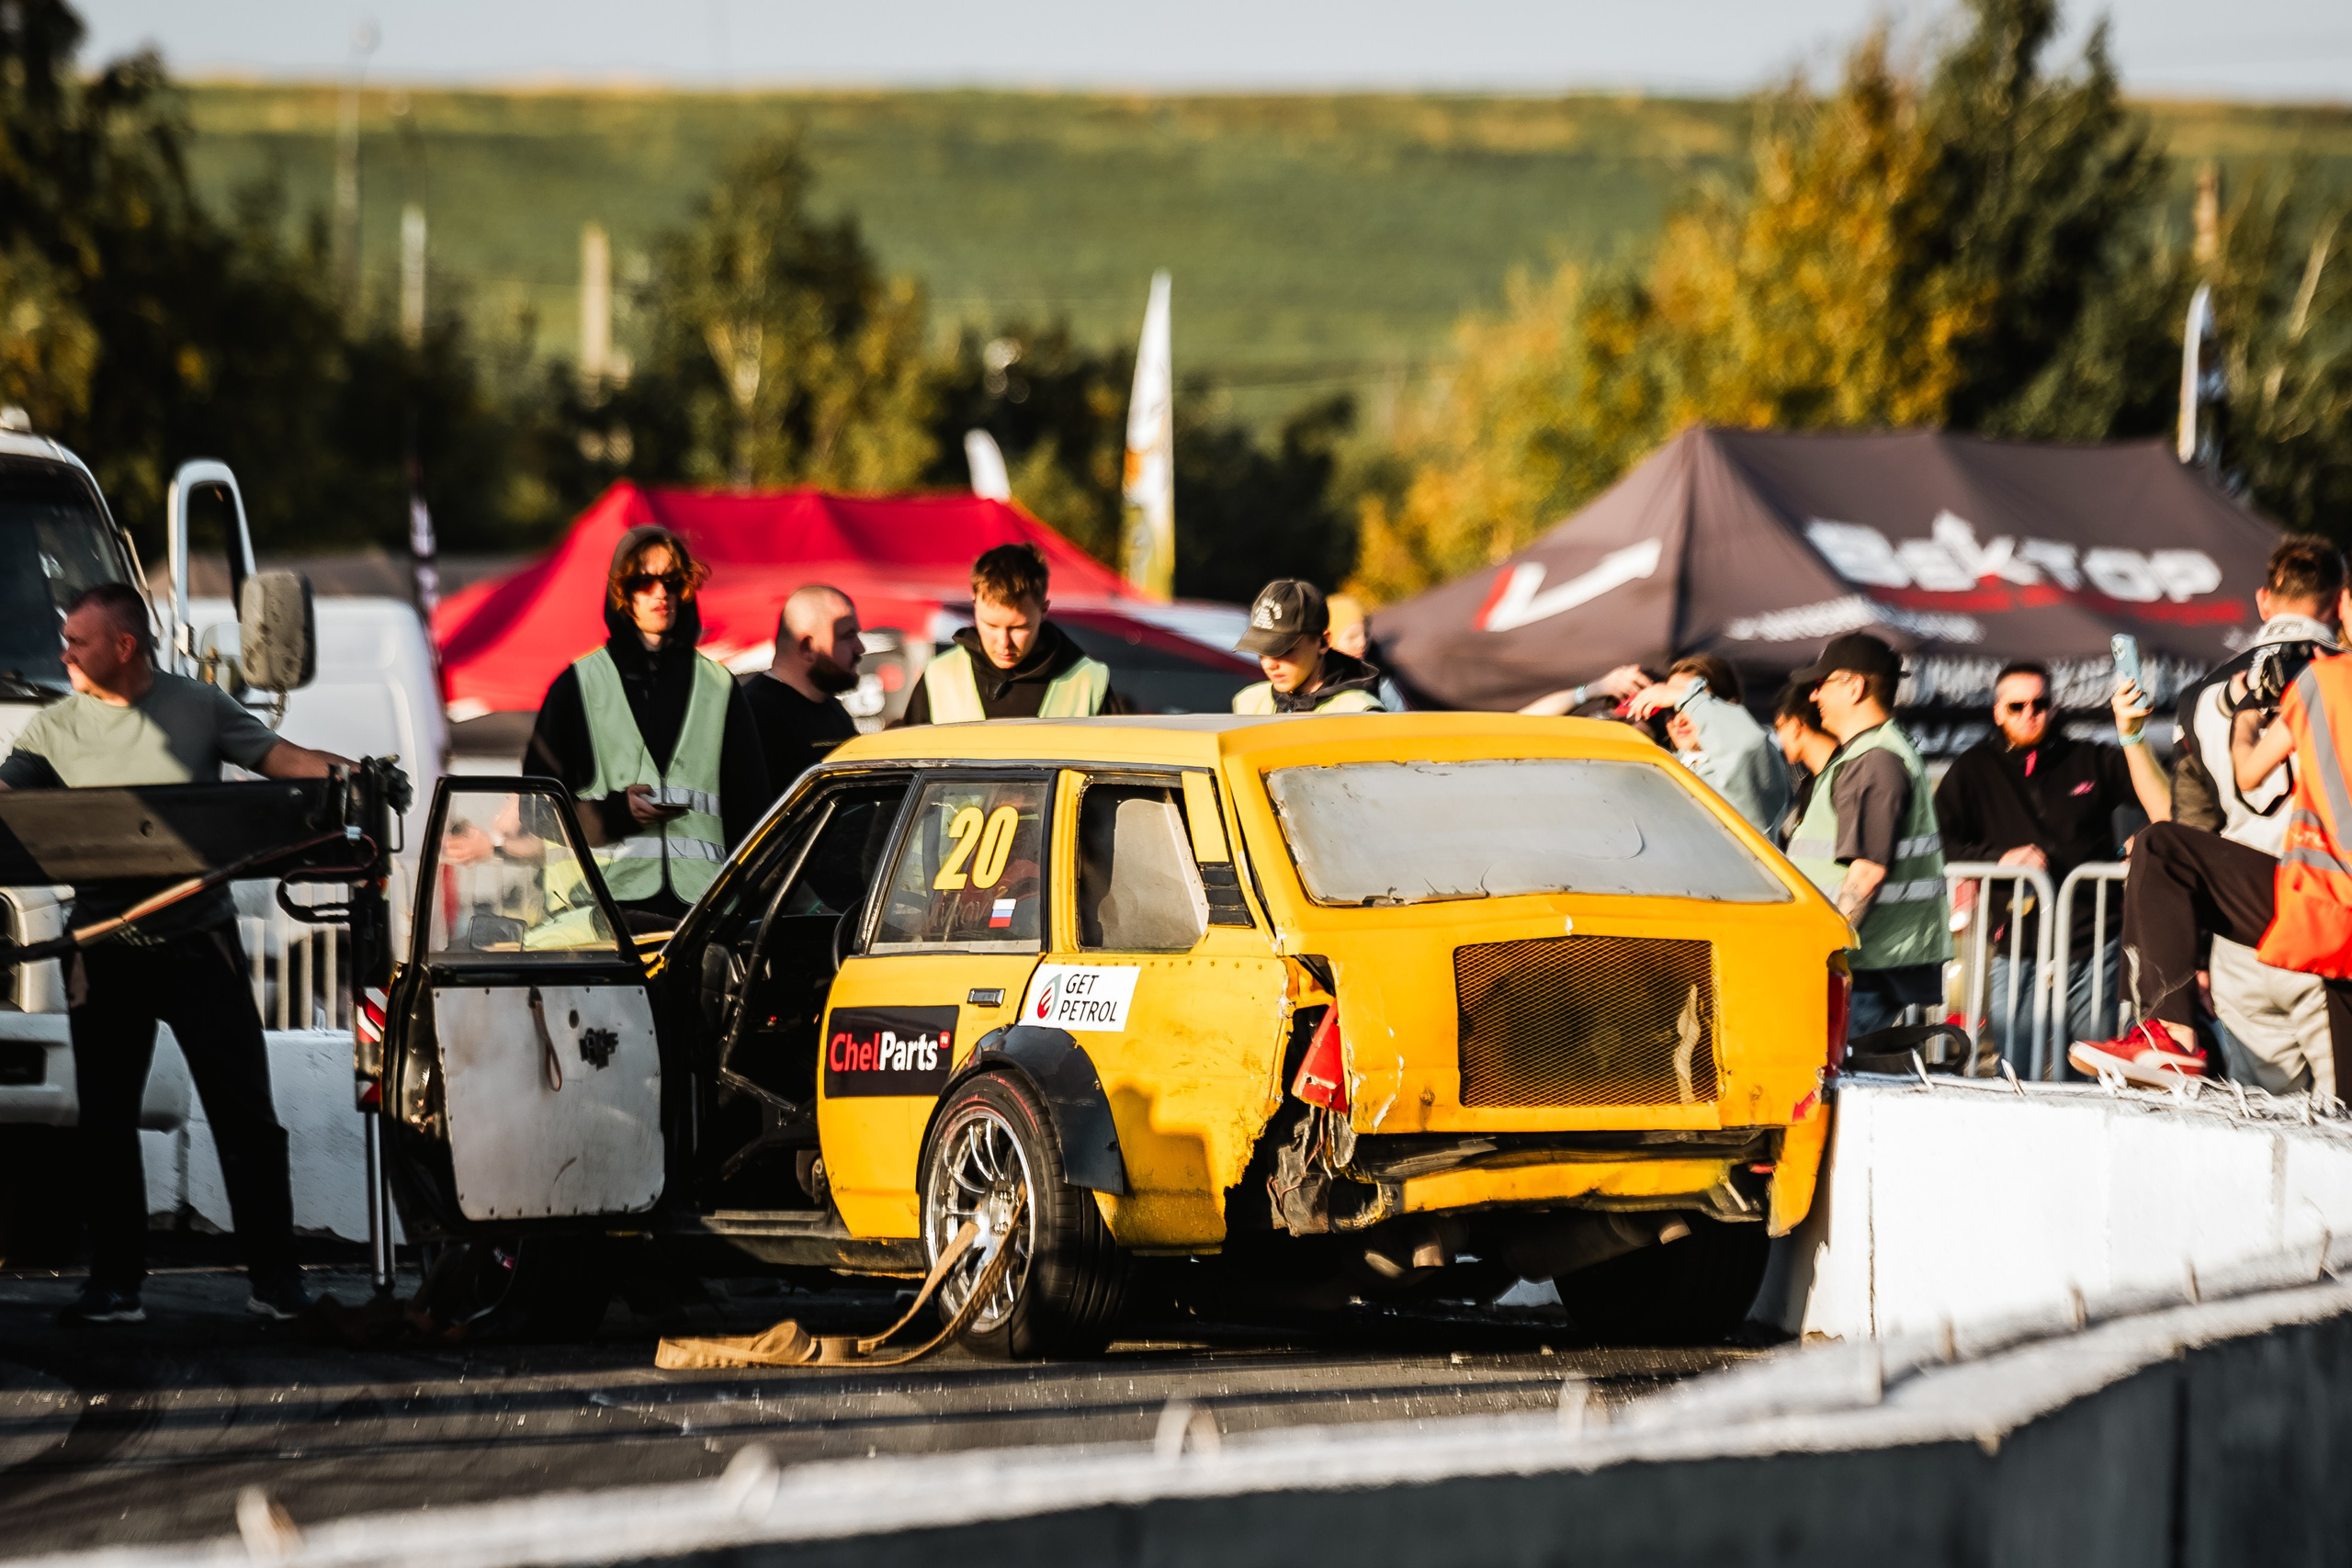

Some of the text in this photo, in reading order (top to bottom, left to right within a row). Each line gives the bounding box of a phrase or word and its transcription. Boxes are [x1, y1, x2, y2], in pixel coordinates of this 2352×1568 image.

[933, 805, 1019, 890] 20
[1066, 974, 1100, 994] GET
[1058, 999, 1117, 1021] PETROL
[830, 1032, 938, 1072] ChelParts
